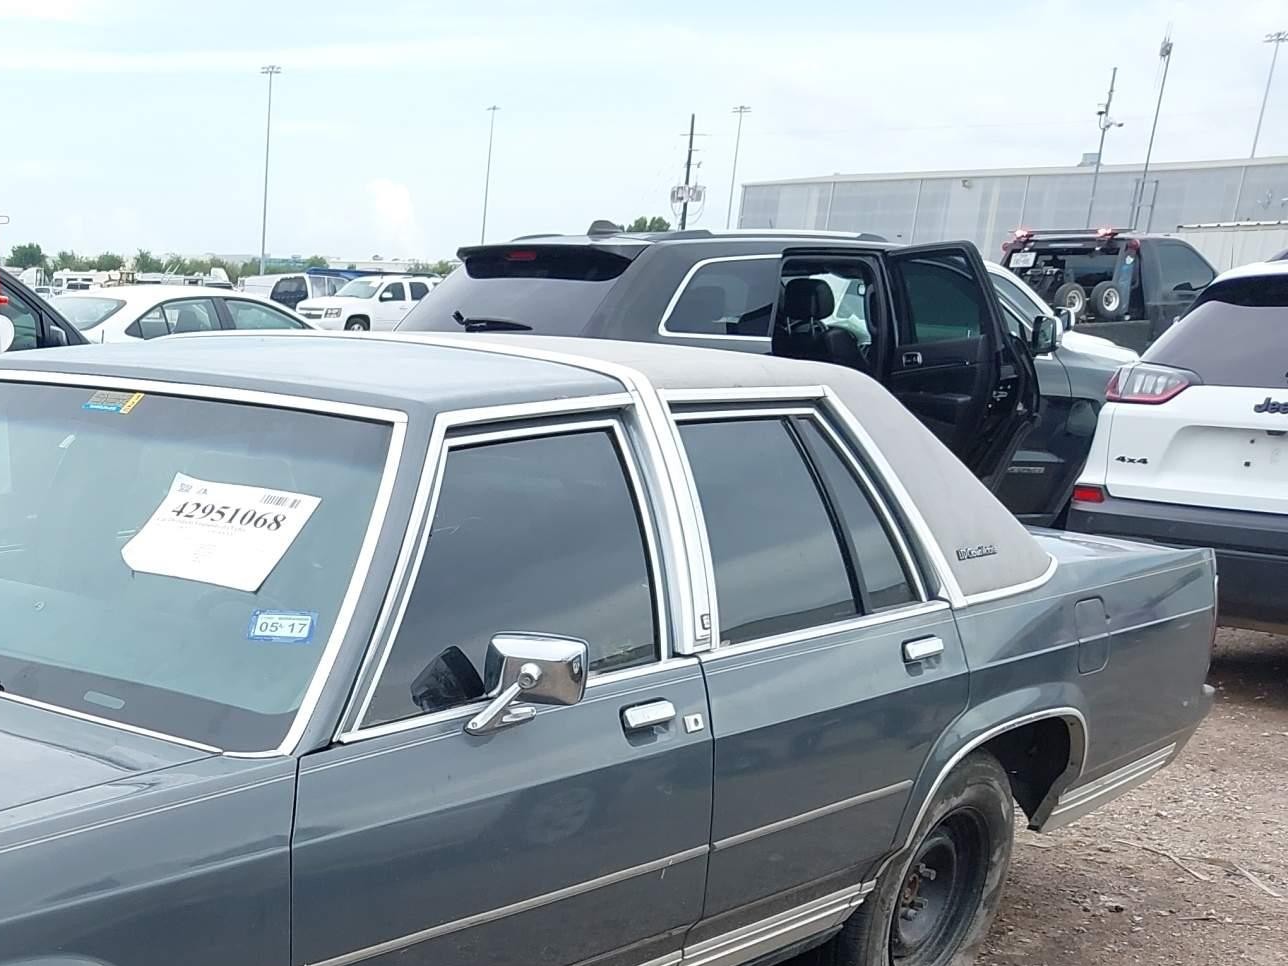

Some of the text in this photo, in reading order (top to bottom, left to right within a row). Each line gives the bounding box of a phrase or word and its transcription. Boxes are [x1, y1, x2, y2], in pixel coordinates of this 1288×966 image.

[1115, 456, 1148, 465] 4x4
[172, 501, 287, 530] 42951068
[259, 622, 307, 634] 05 17
